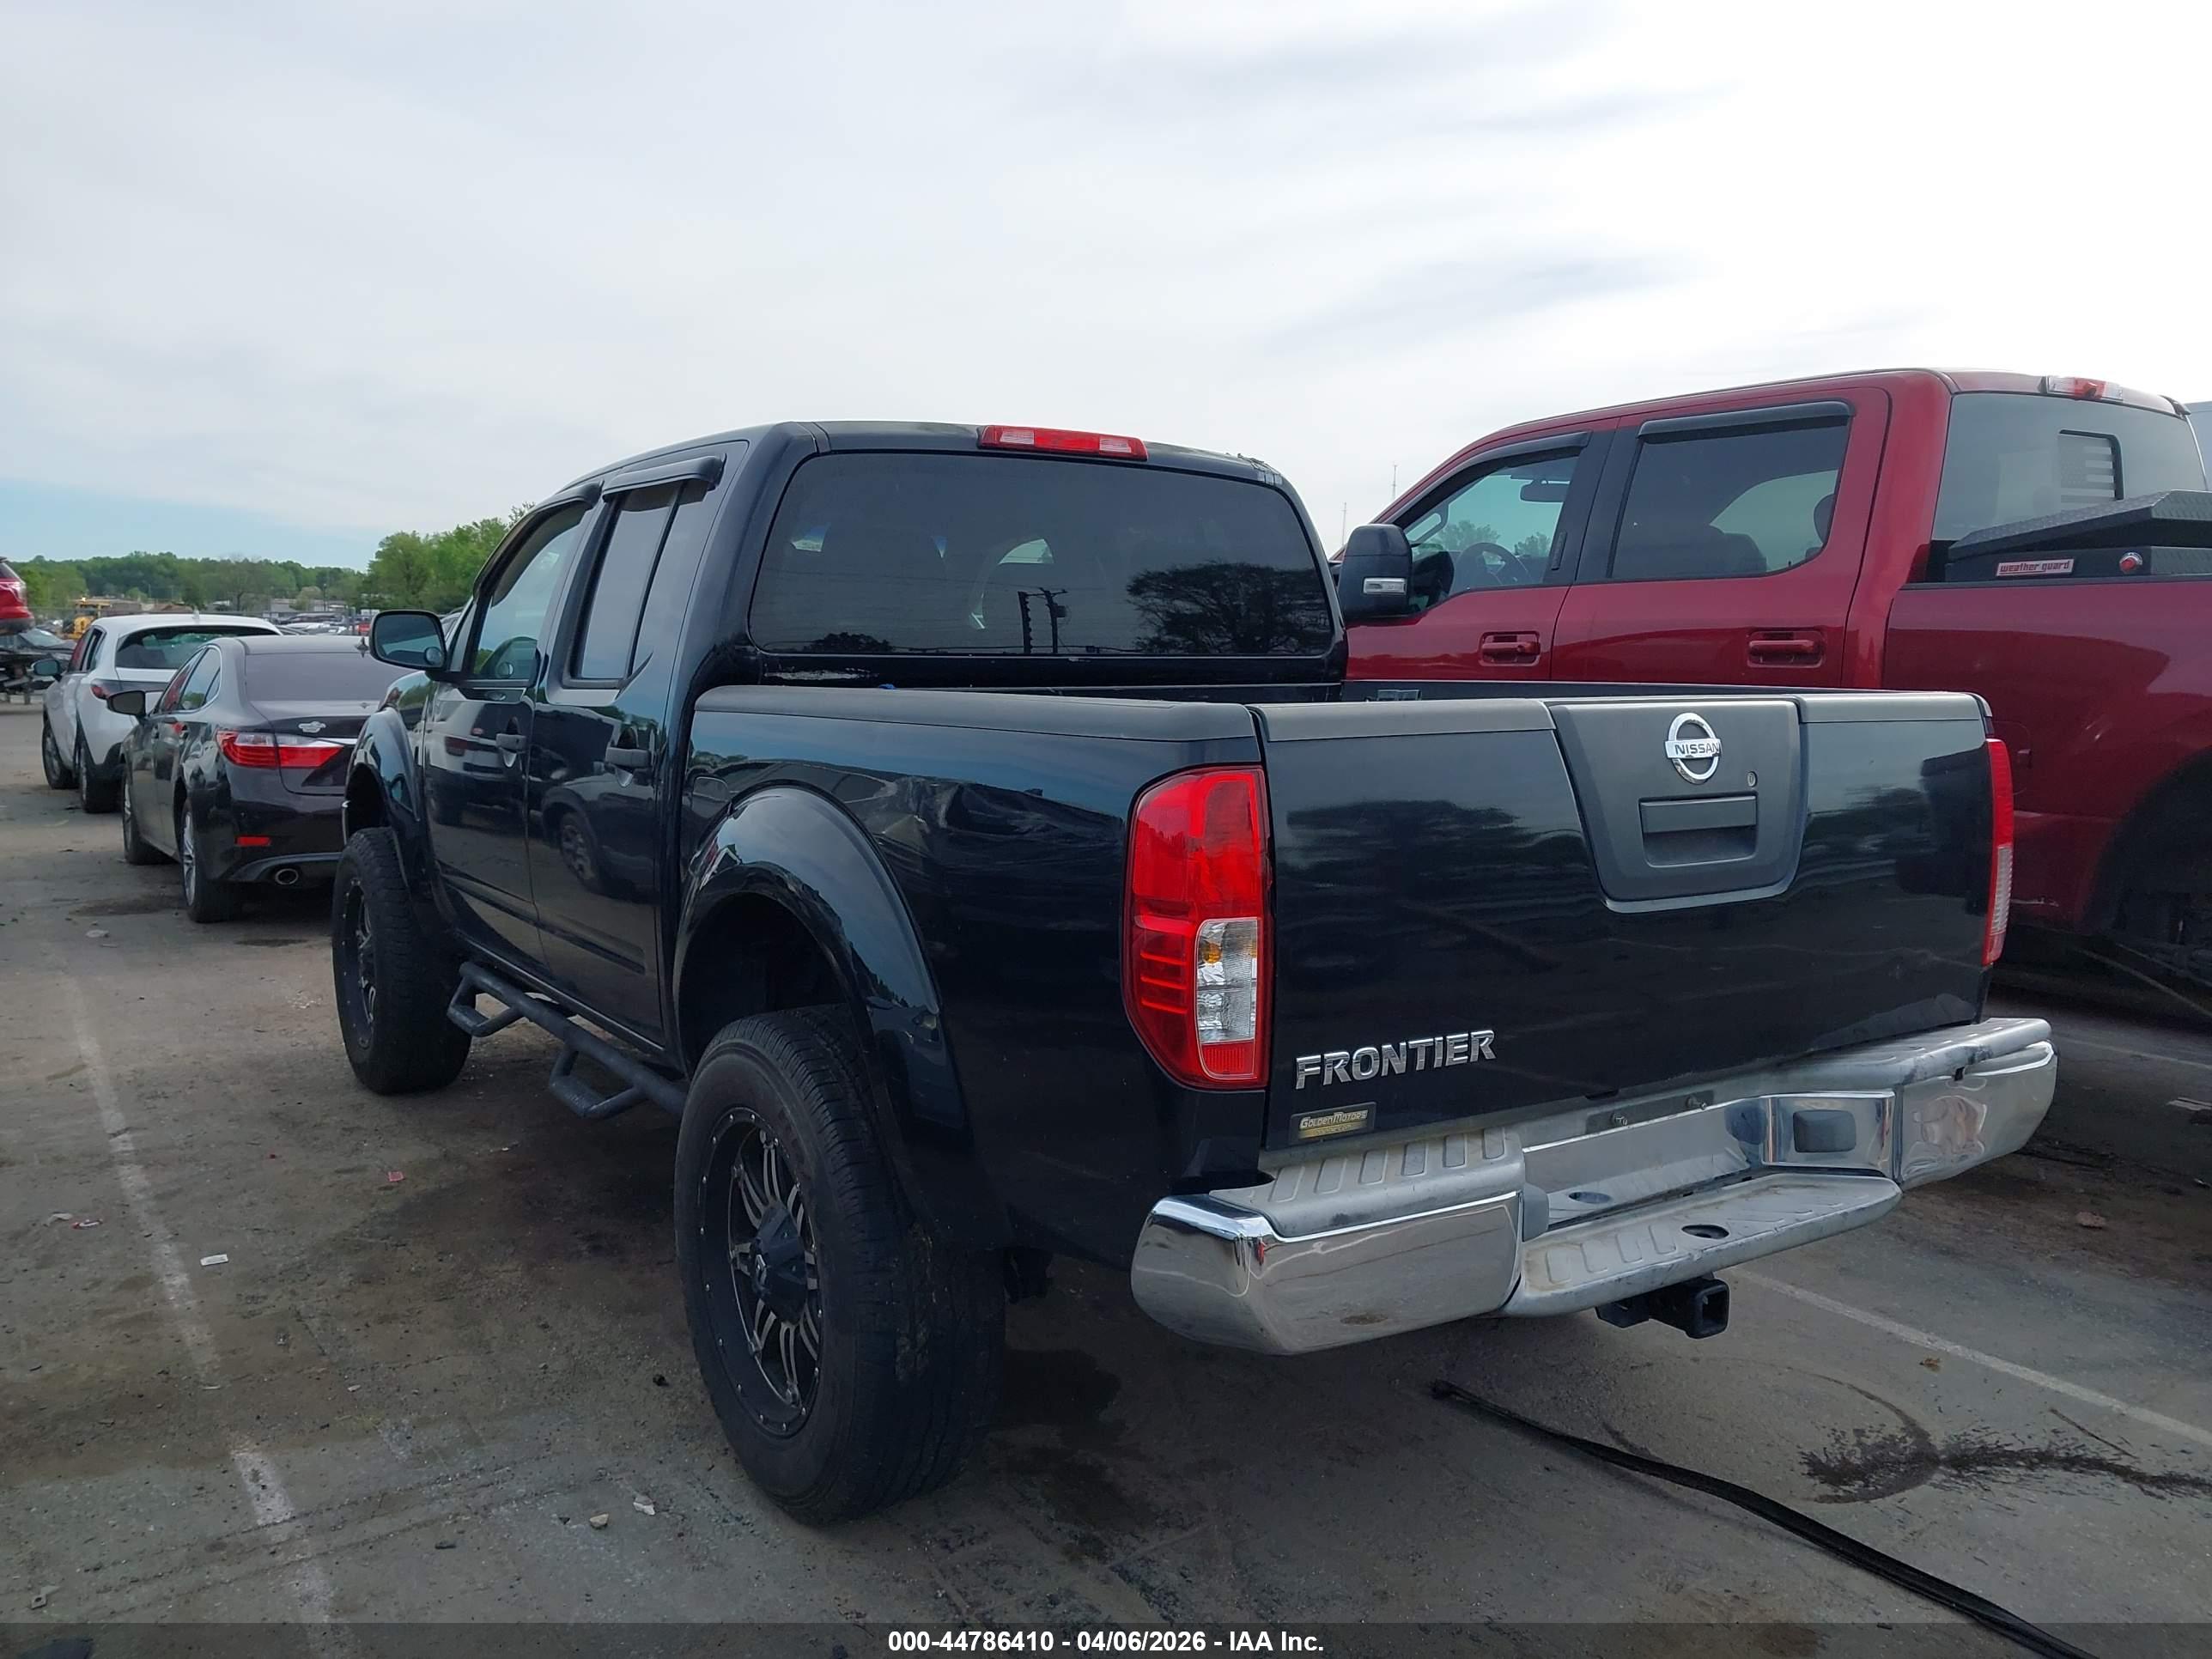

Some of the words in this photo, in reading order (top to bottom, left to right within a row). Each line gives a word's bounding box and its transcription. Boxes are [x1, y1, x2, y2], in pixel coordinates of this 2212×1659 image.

[2000, 563, 2039, 572] weather
[2041, 561, 2069, 573] guard
[1674, 743, 1720, 754] NISSAN
[1296, 1030, 1496, 1089] FRONTIER
